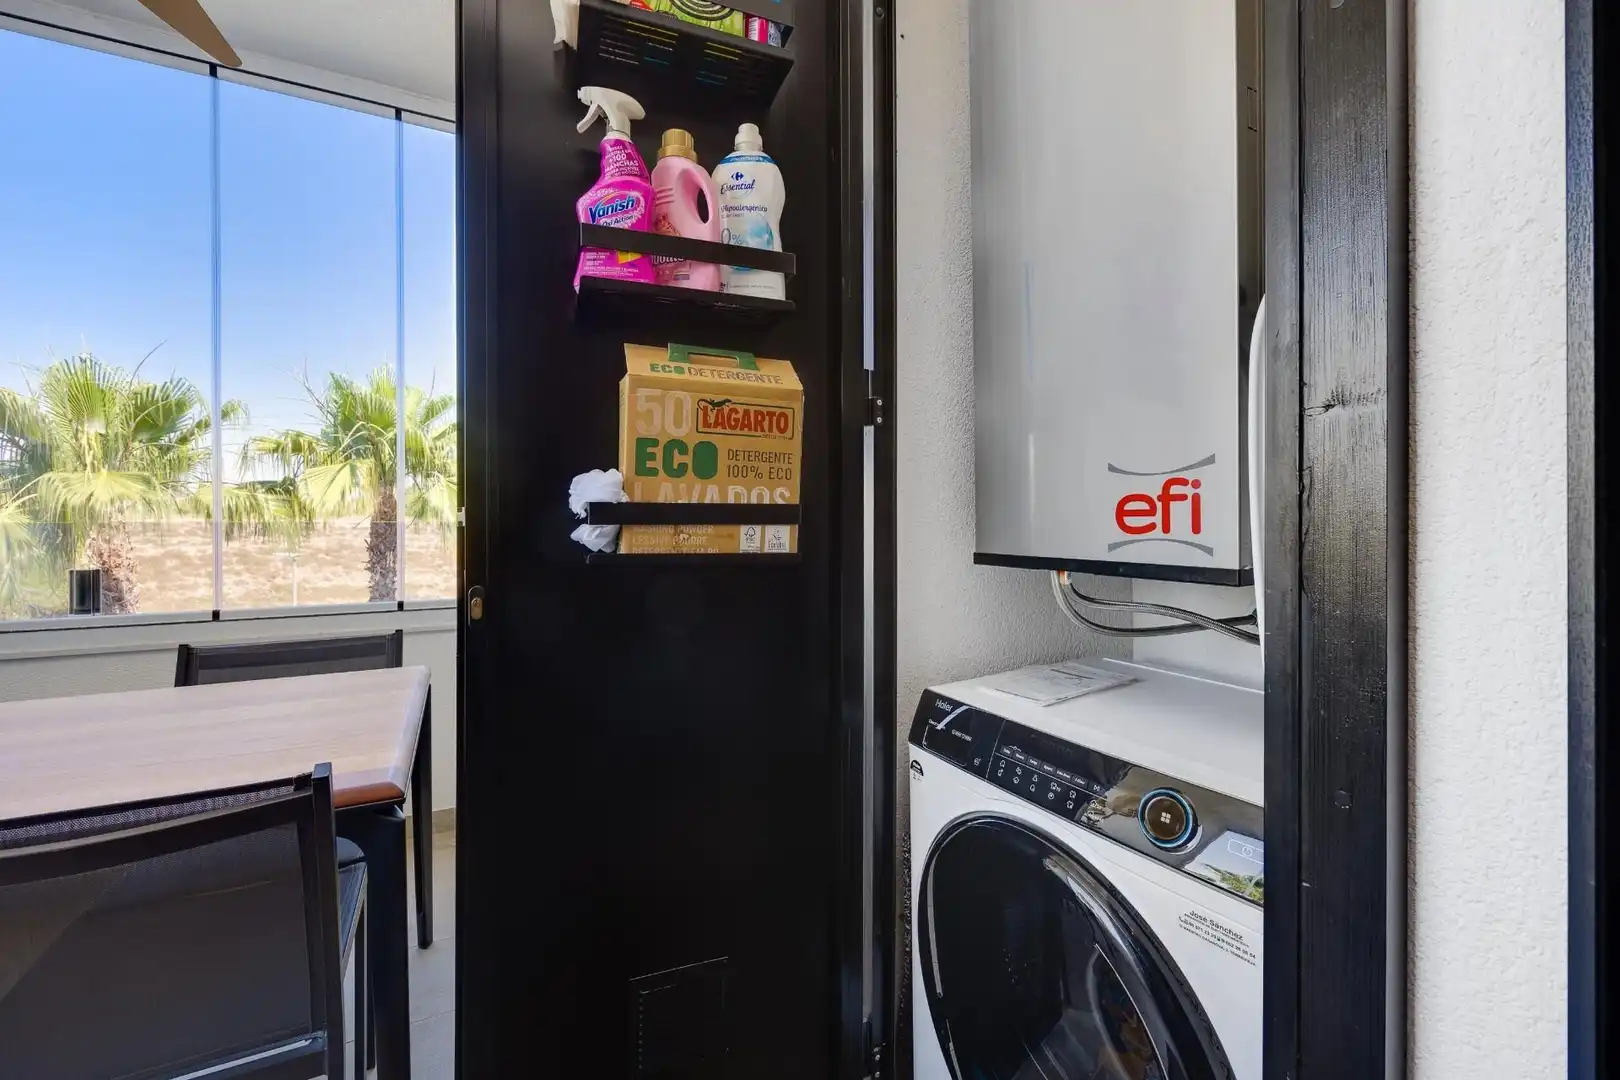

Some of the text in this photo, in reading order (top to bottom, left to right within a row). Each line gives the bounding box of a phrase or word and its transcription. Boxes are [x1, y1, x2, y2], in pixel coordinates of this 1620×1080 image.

[720, 179, 756, 195] Essential
[588, 195, 636, 225] Vanish
[614, 215, 635, 225] Action
[650, 362, 785, 386] ECO DETERGENTE
[636, 388, 692, 437] 50
[702, 405, 790, 435] LAGARTO
[634, 437, 719, 480] ECO
[727, 448, 794, 465] DETERGENTE
[727, 464, 793, 481] 100% ECO
[1115, 477, 1202, 535] efi
[935, 698, 954, 712] Haier
